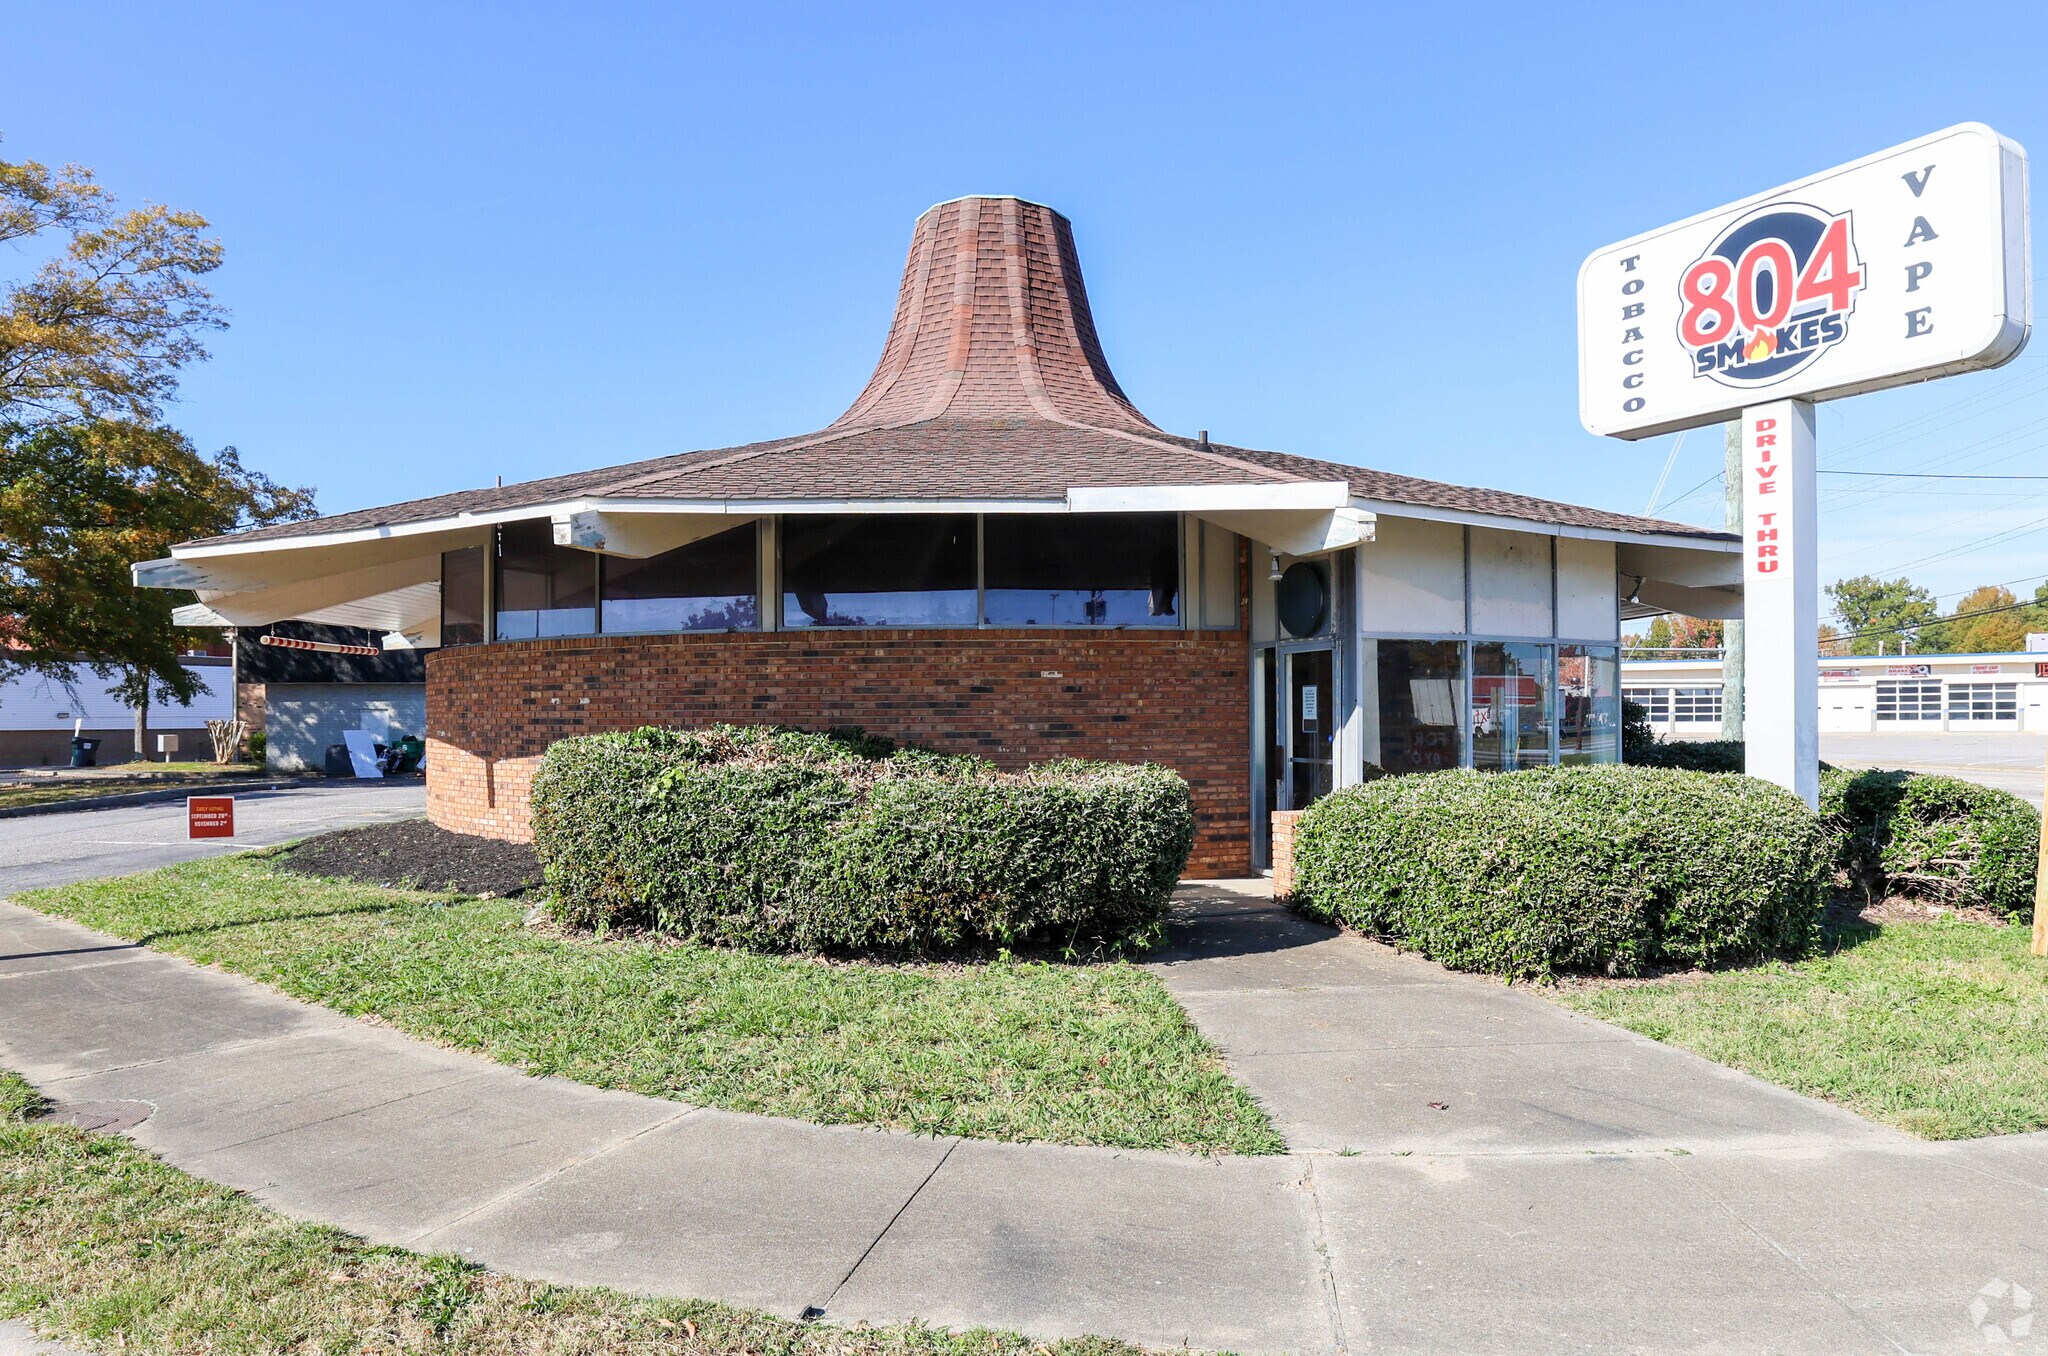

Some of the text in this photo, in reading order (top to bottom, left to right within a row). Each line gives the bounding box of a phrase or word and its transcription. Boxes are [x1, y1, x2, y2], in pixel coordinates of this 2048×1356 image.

[1682, 217, 1861, 347] 804
[1901, 164, 1939, 339] VAPE
[1619, 254, 1646, 413] TOBACCO
[1755, 418, 1779, 574] DRIVE THRU
